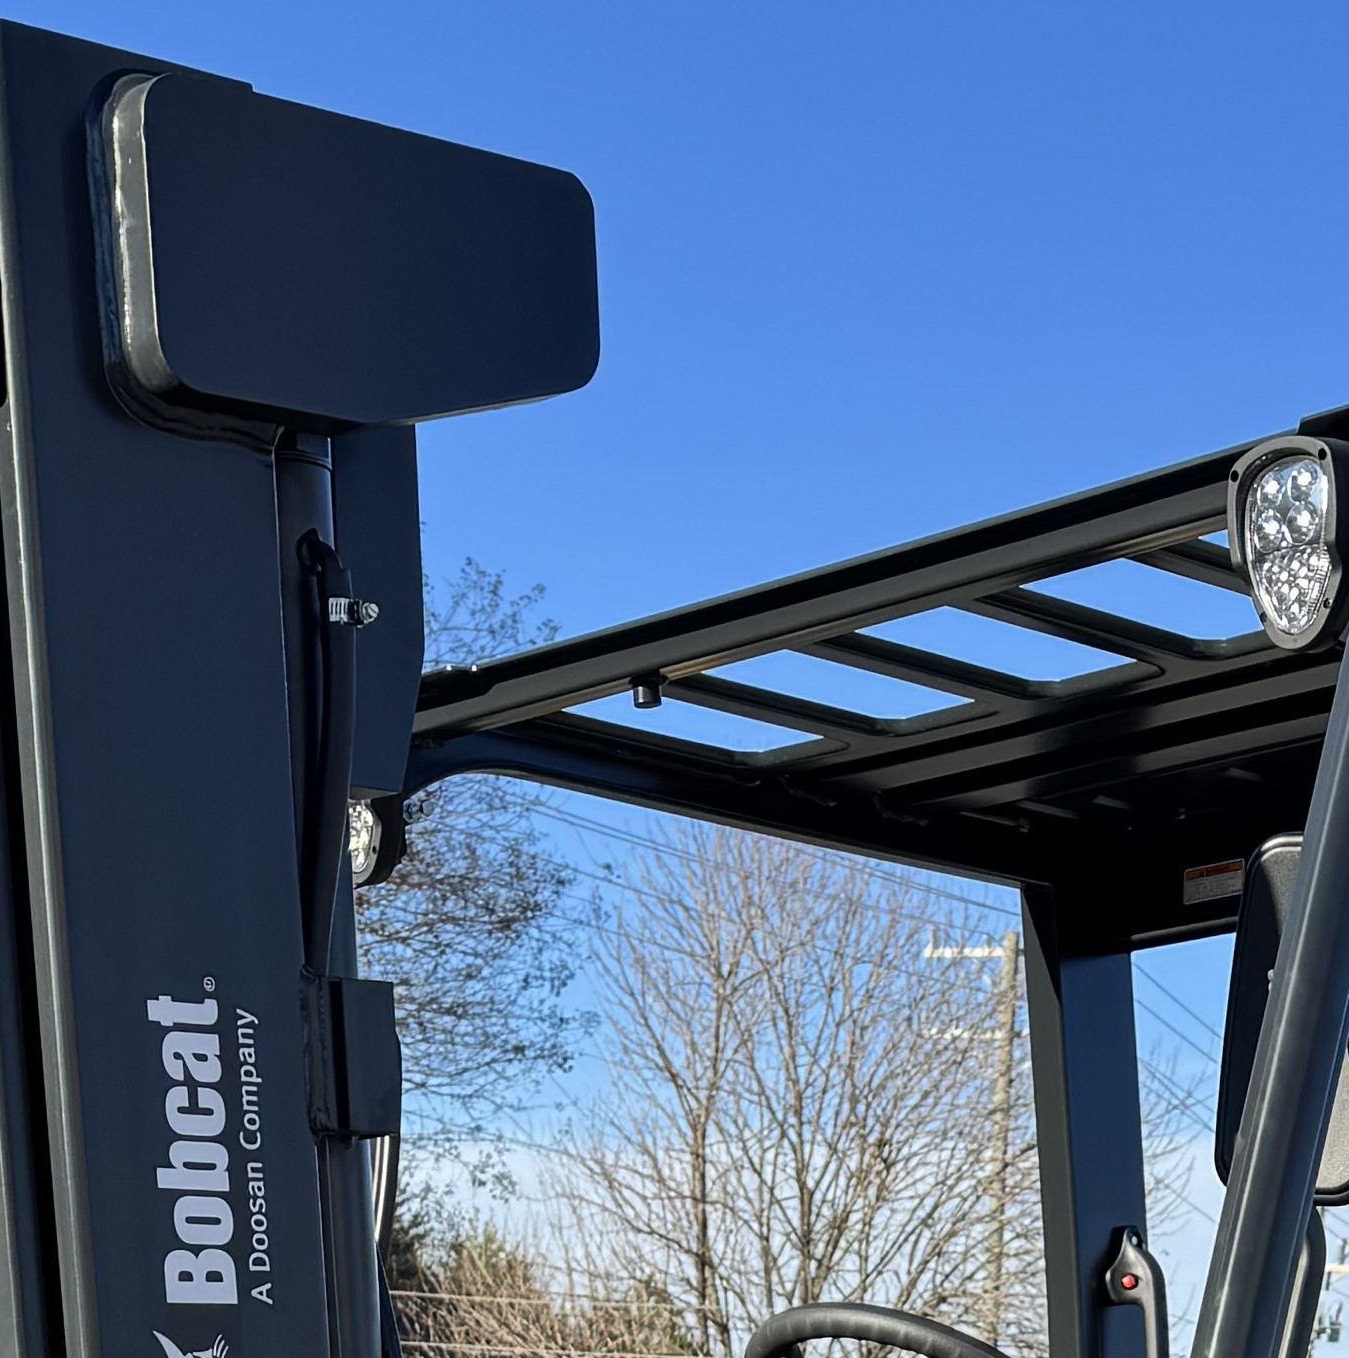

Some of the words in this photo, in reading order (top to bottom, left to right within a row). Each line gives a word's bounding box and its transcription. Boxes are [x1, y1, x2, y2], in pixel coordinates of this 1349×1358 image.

[236, 1008, 262, 1151] Company
[147, 995, 238, 1304] Bobcat
[248, 1162, 271, 1272] Doosan
[251, 1282, 273, 1304] A
